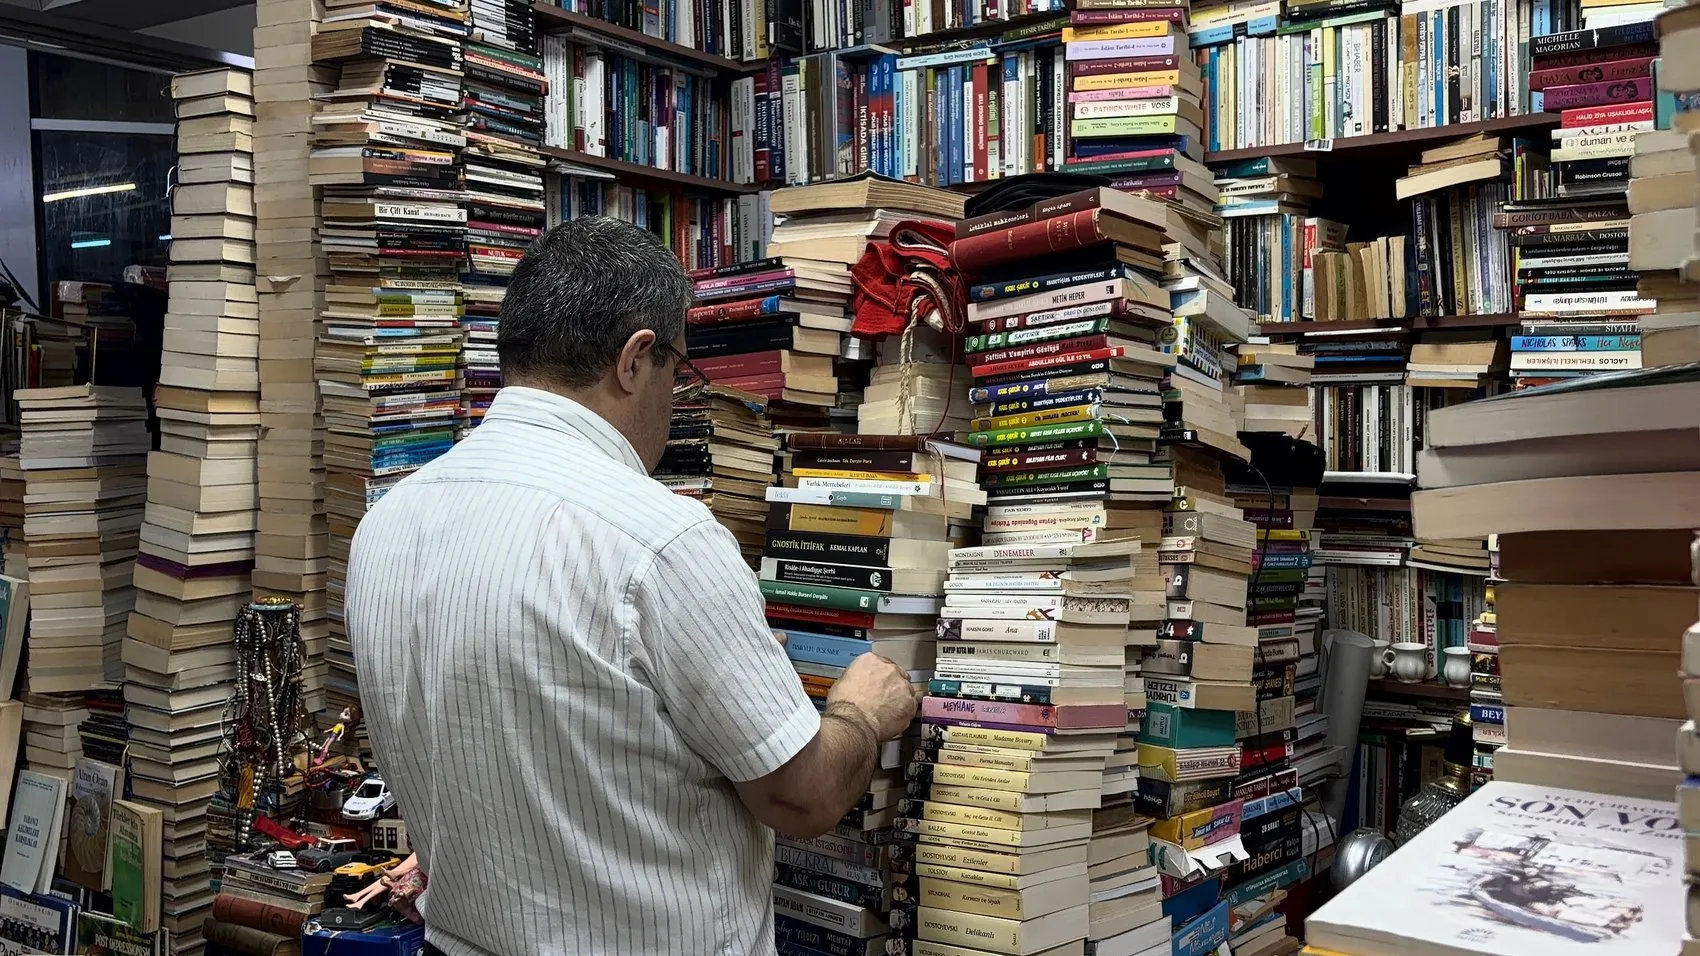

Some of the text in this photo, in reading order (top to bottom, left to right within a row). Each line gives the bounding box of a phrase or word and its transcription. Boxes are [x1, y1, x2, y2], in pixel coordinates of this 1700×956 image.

[1537, 33, 1580, 44] MICHELLE
[1535, 41, 1580, 53] MAGORIAN
[1539, 72, 1571, 85] DAVA
[1094, 105, 1122, 113] PATRICK
[1151, 101, 1170, 109] VOSS
[1580, 134, 1627, 147] duman ve
[860, 147, 868, 168] GİRİŞ
[379, 206, 387, 214] Bir
[390, 206, 401, 216] Çift
[403, 207, 420, 216] Kanat
[1549, 212, 1573, 222] BABA
[1588, 210, 1618, 218] BALZAC
[1543, 232, 1585, 243] KUMARBAZ
[1052, 291, 1085, 304] METİN HEPER
[1521, 337, 1613, 348] NICHOLAS SPARKS Her
[1028, 358, 1054, 367] ABDULLAH
[1055, 356, 1065, 364] GÜL
[772, 538, 868, 553] GNOSTİK İTTİFAK KEMAL KAPLAN
[994, 549, 1035, 558] DENEMELER
[1005, 626, 1018, 634] Ana
[1148, 681, 1178, 692] TEZLER
[943, 701, 975, 713] MEYHANE
[1488, 795, 1598, 821] SON
[781, 847, 800, 863] BUZ
[922, 852, 988, 866] DOSTOYEVSKİ Ezilenler
[1242, 848, 1283, 873] Haberci
[928, 868, 984, 881] TOLSTOY Kazaklar
[792, 873, 850, 898] AŞK GURUR
[928, 889, 951, 898] STENDHAL
[925, 921, 994, 938] DOSTOYEVSKİ Delikanlı
